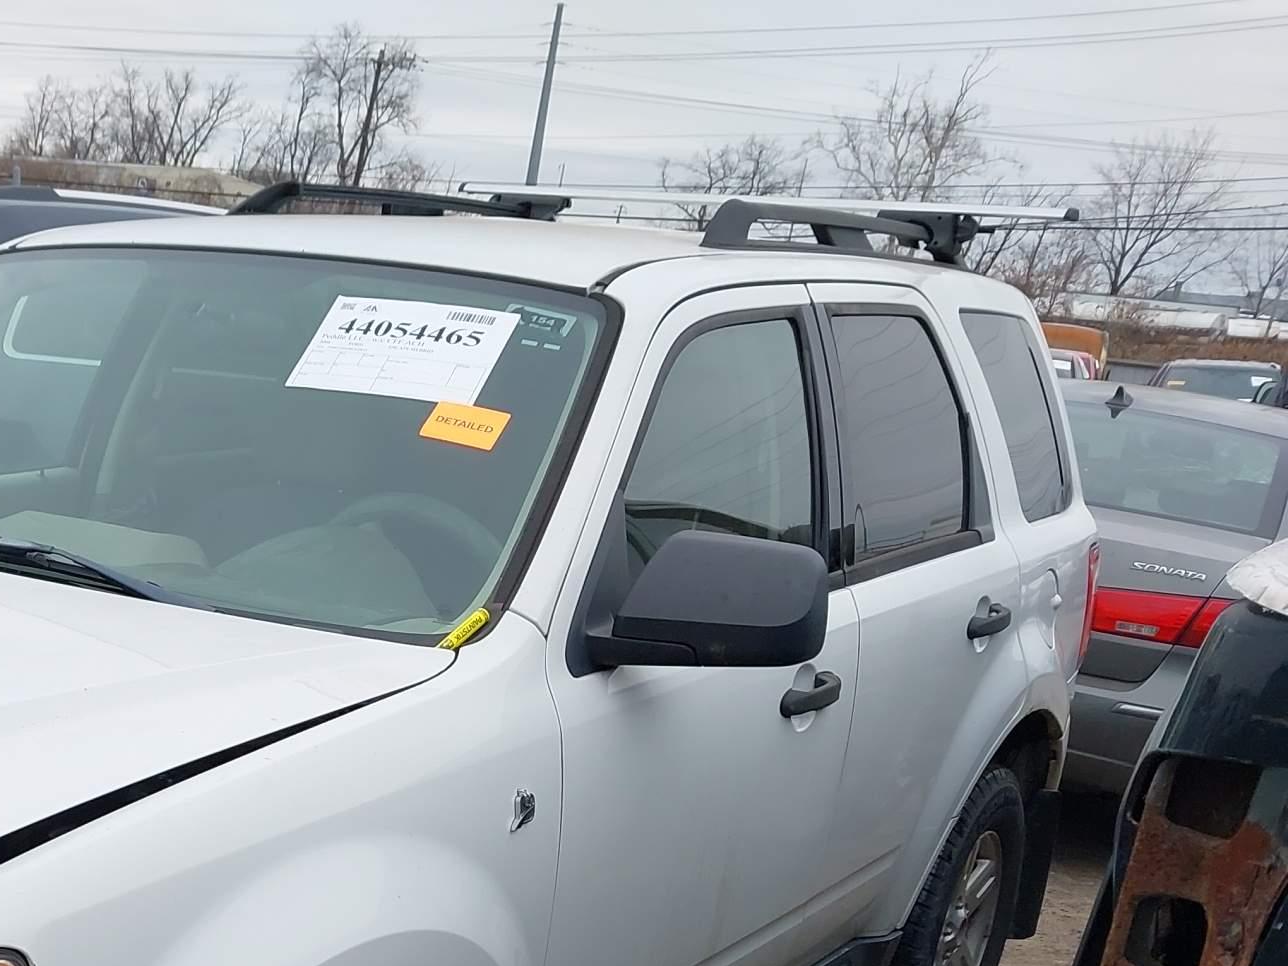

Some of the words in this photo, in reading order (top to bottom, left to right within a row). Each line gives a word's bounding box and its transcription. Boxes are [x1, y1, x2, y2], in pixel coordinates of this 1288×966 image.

[338, 317, 485, 347] 44054465
[435, 414, 494, 434] DETAILED
[1129, 561, 1207, 581] SONATA
